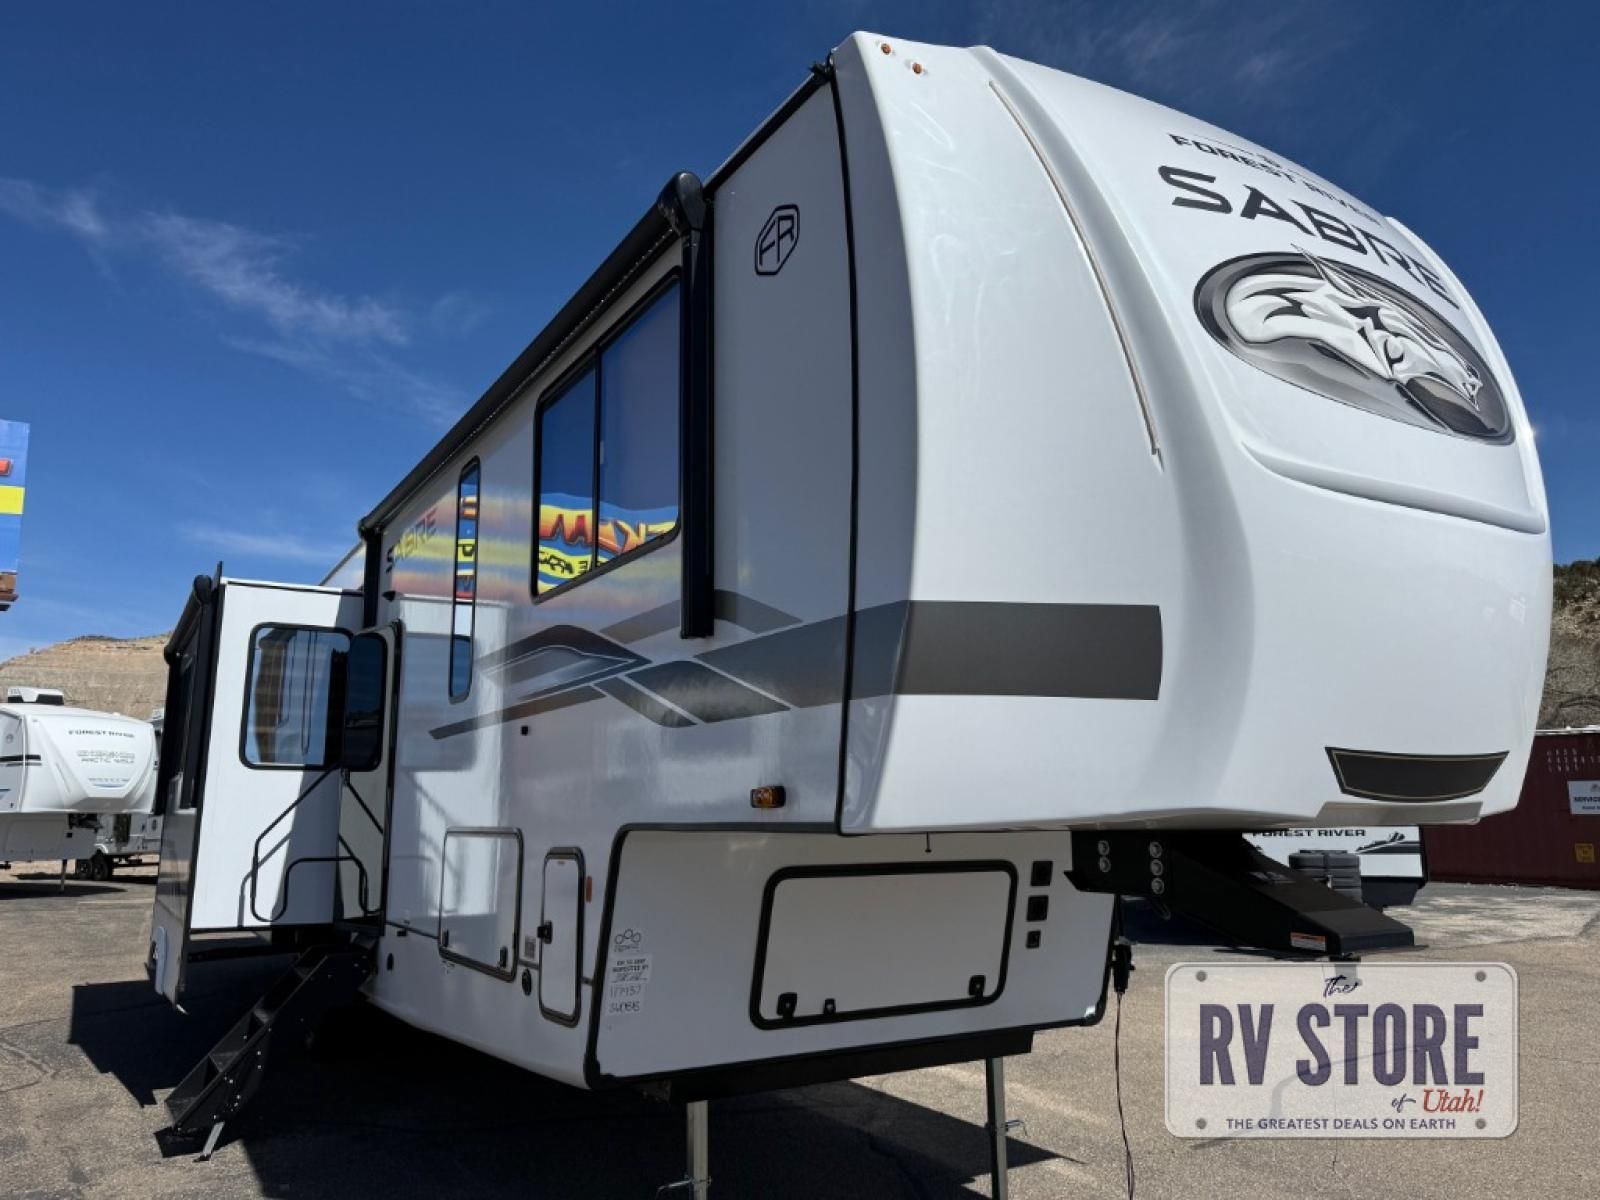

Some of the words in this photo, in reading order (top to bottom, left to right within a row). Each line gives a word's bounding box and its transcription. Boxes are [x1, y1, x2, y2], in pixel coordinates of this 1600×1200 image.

[1167, 132, 1296, 184] FOREST
[1157, 165, 1460, 309] SABRE
[385, 506, 438, 575] SABRE
[1319, 829, 1367, 837] RIVER
